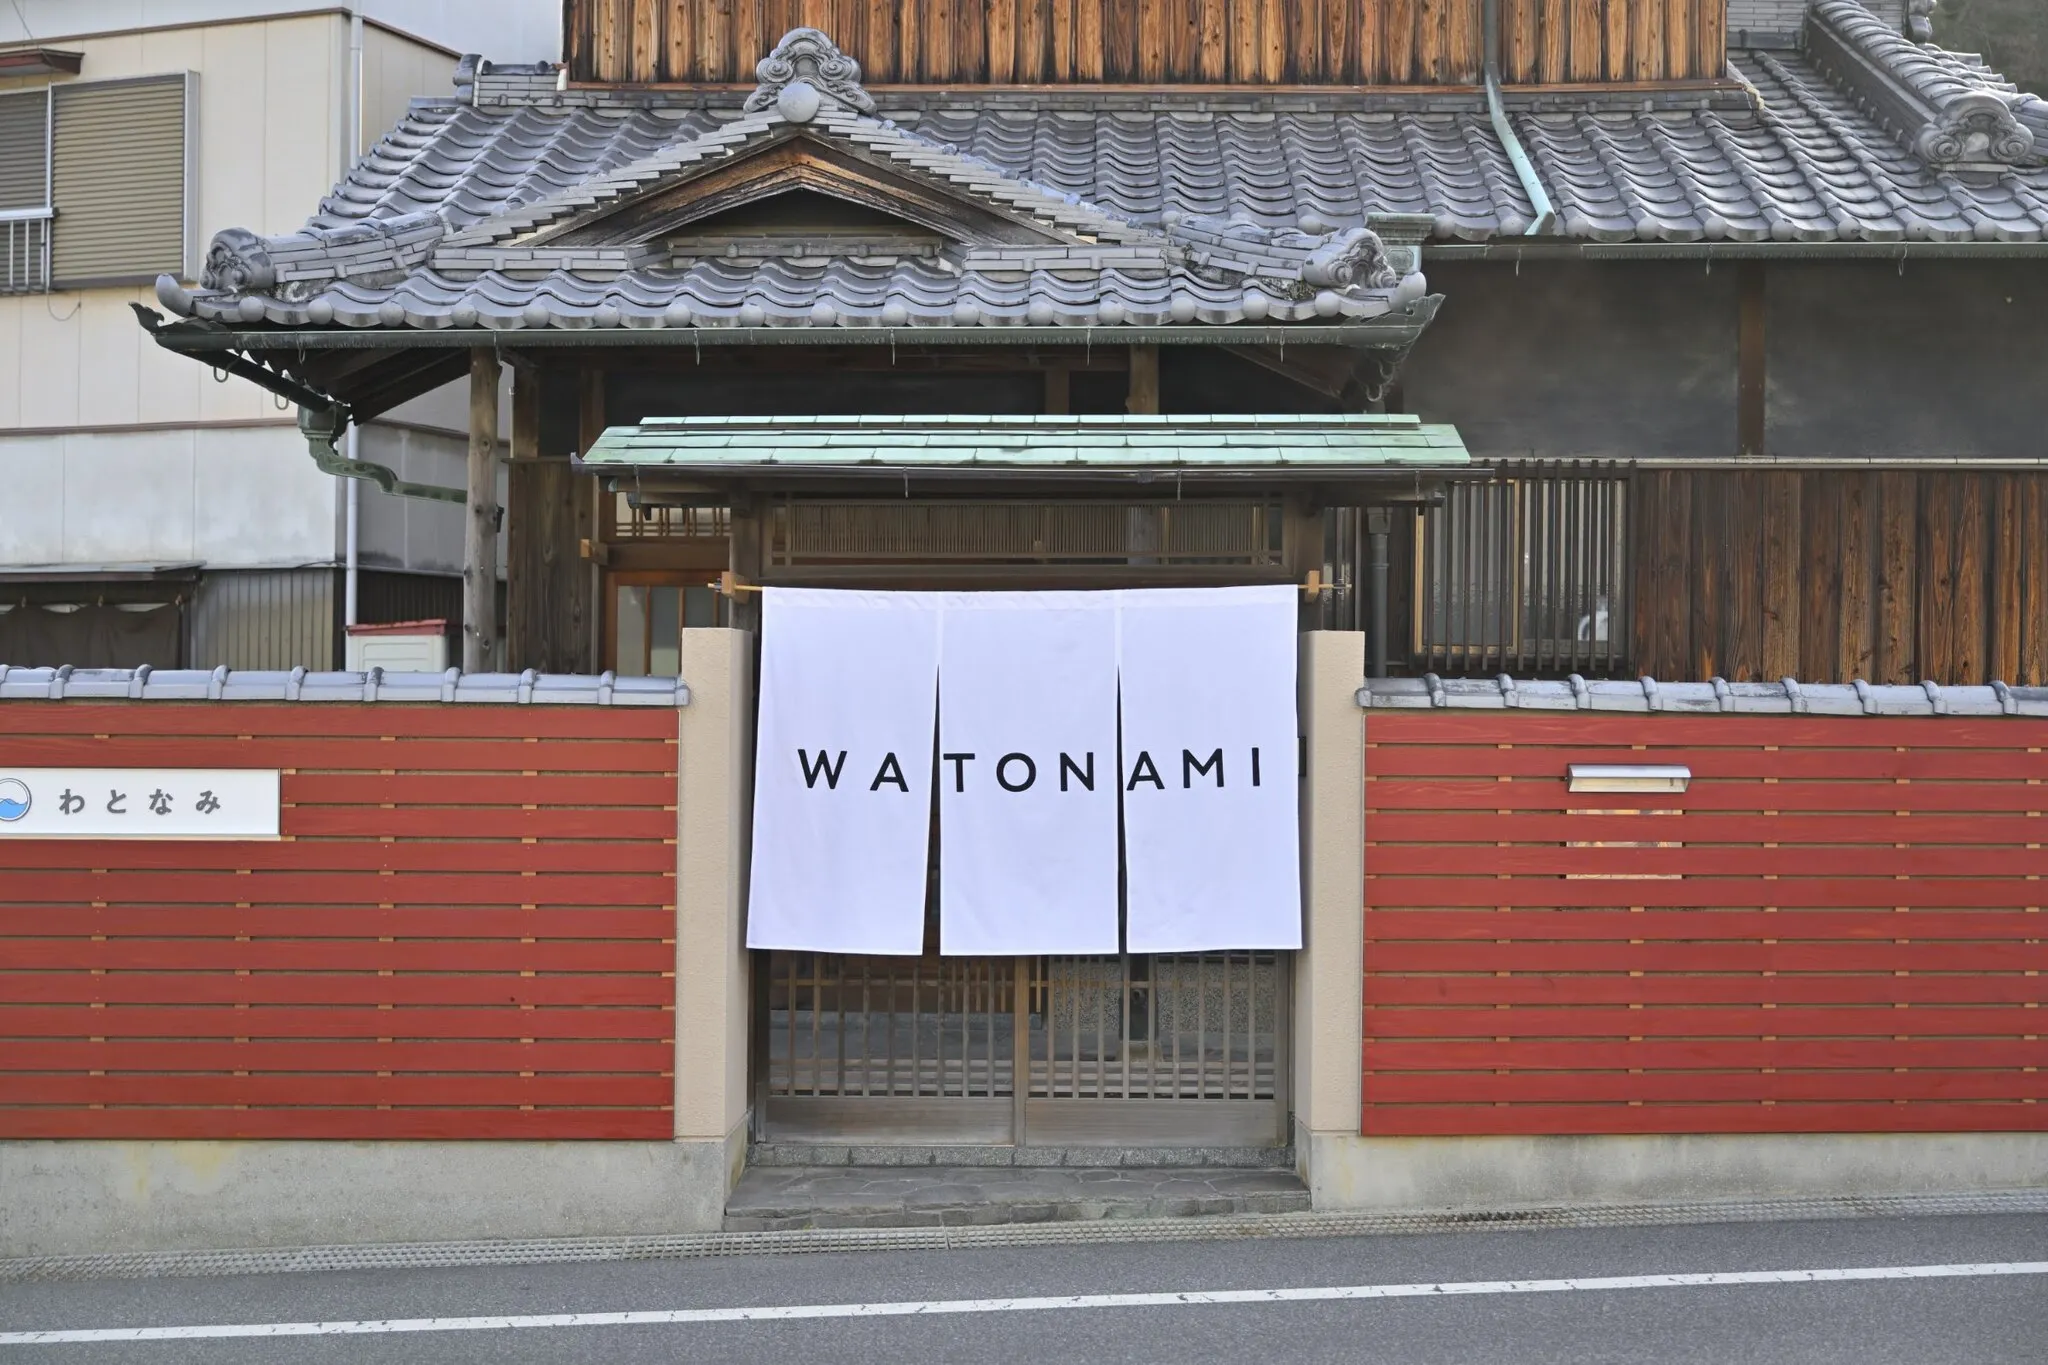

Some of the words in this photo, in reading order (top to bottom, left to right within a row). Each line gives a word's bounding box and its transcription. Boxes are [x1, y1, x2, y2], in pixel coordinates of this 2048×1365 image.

[797, 747, 1261, 793] WATONAMI
[58, 788, 221, 815] わとなみ
